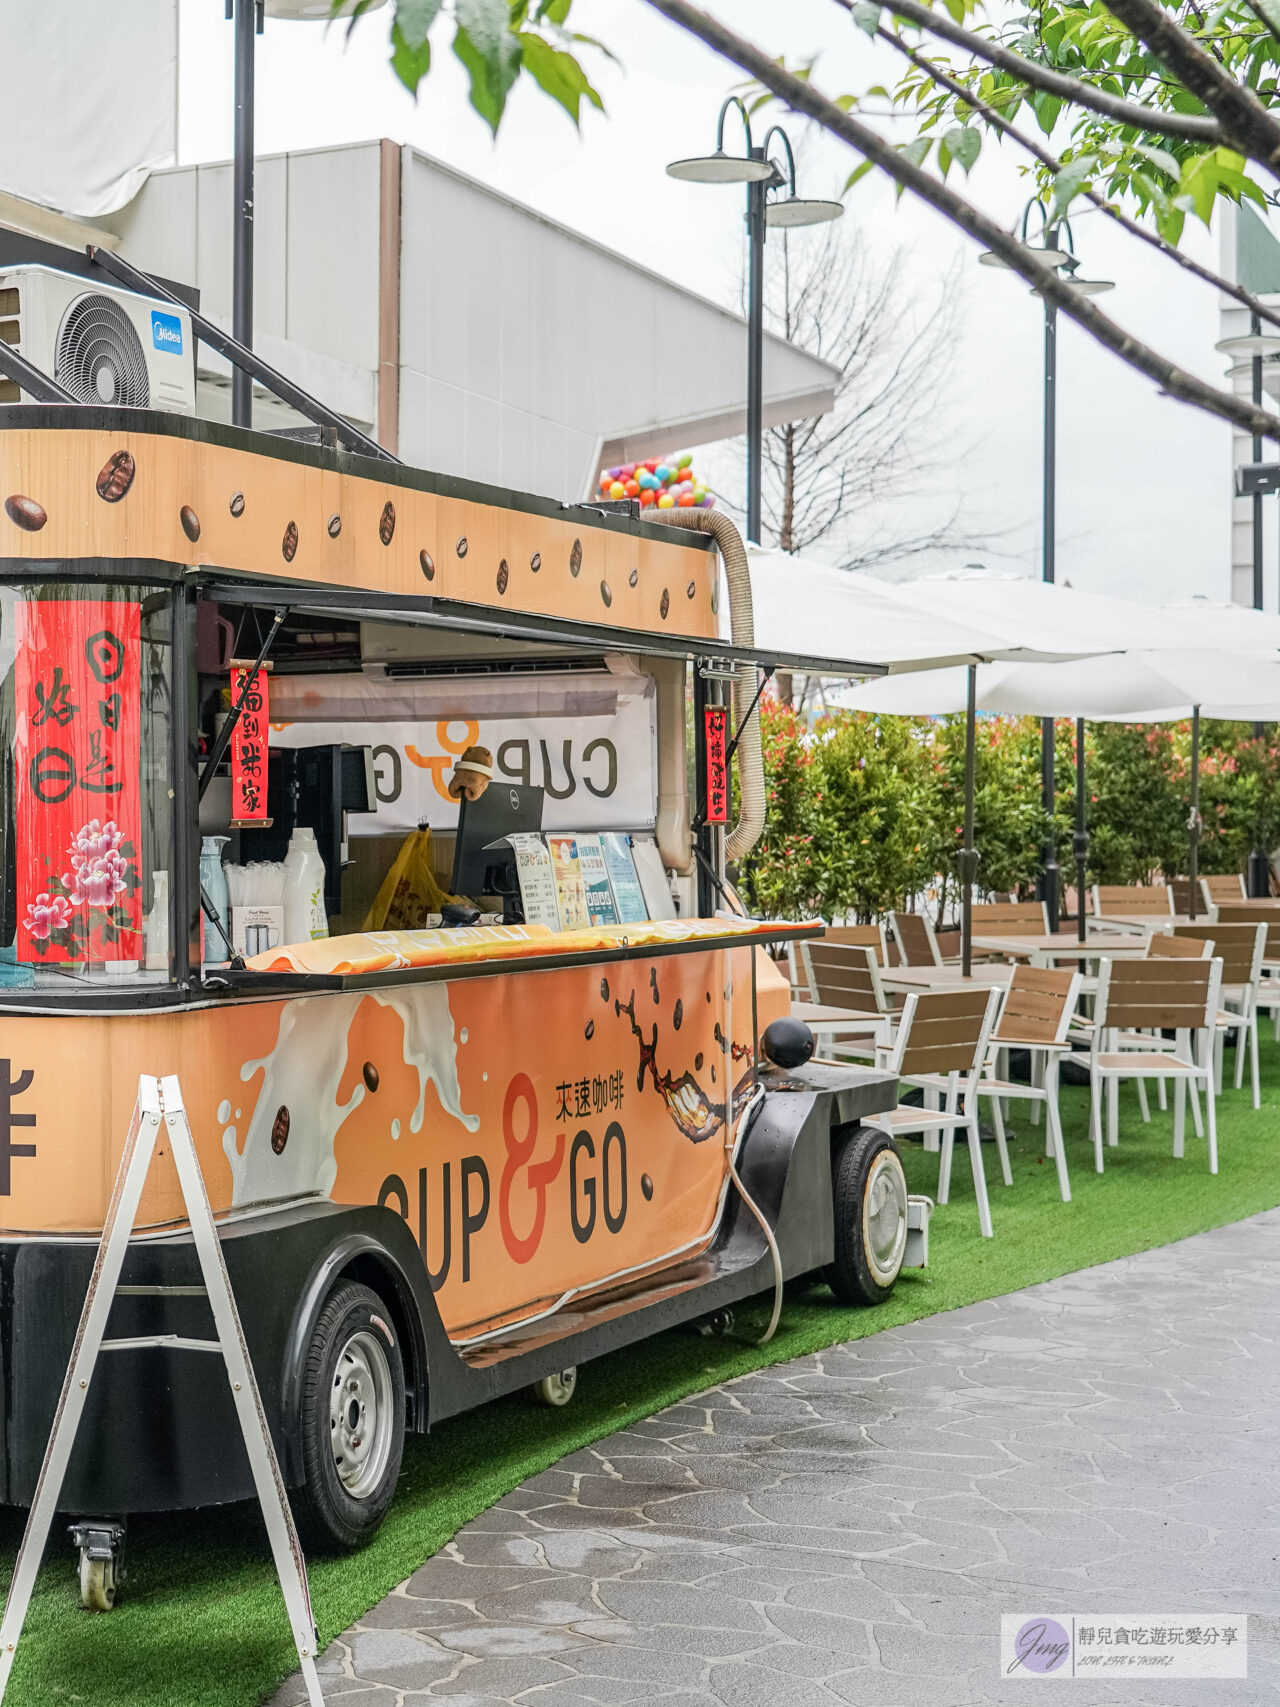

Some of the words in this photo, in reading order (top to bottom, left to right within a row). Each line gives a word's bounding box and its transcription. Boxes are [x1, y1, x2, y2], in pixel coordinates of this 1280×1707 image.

[154, 321, 181, 344] Midea
[555, 1069, 625, 1123] 來速咖啡
